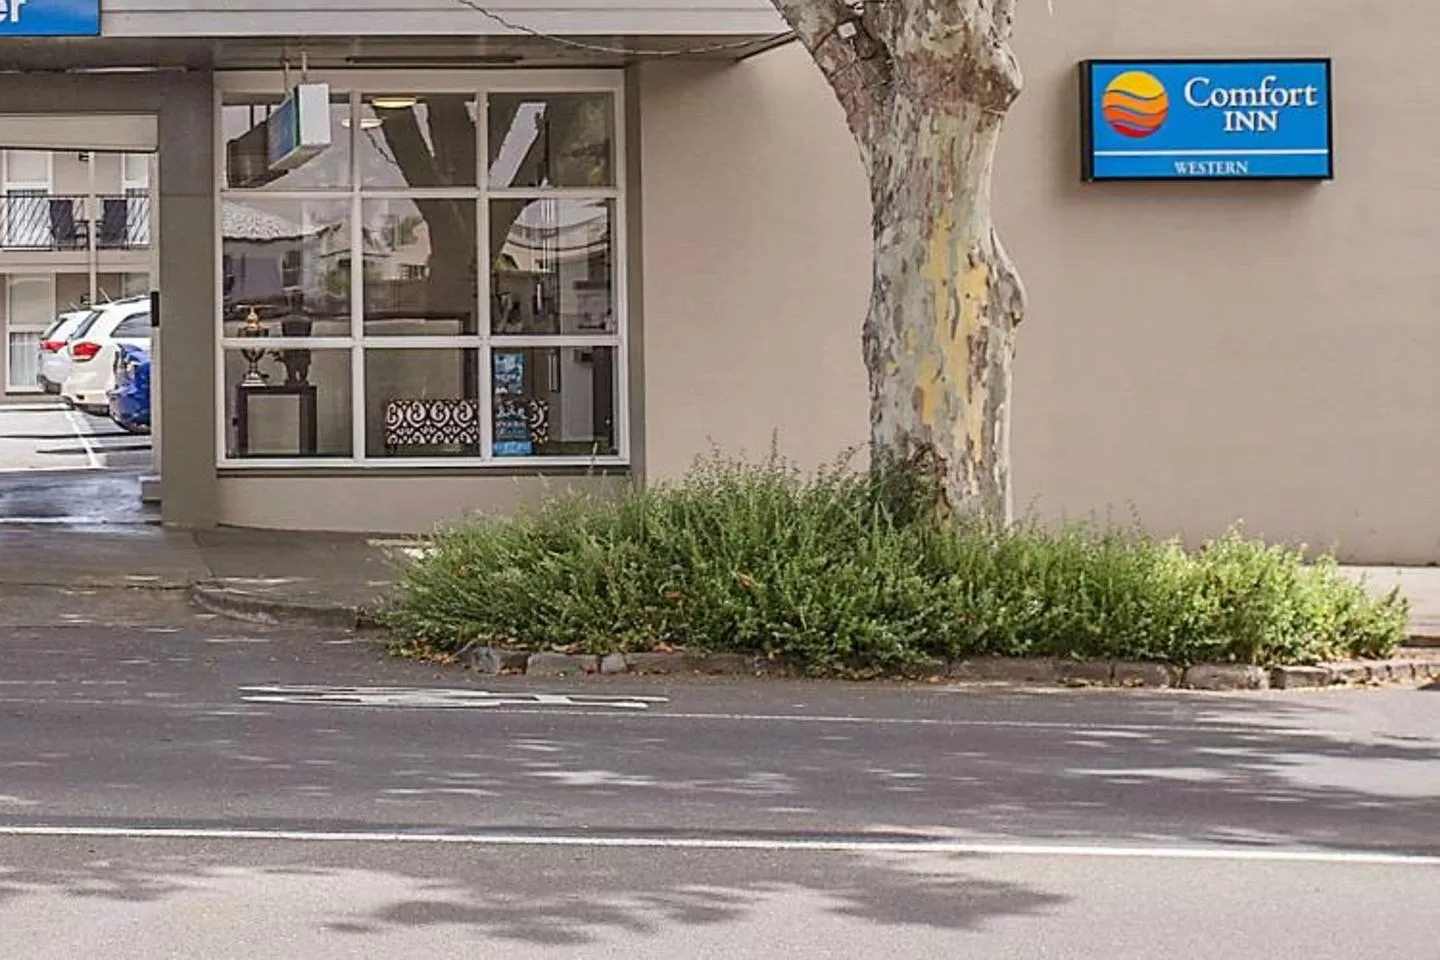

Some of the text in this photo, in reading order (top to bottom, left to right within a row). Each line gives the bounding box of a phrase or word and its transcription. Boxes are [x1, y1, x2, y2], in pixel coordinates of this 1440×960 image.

[1184, 75, 1318, 108] Comfort
[1222, 110, 1279, 132] INN
[1174, 160, 1249, 175] WESTERN
